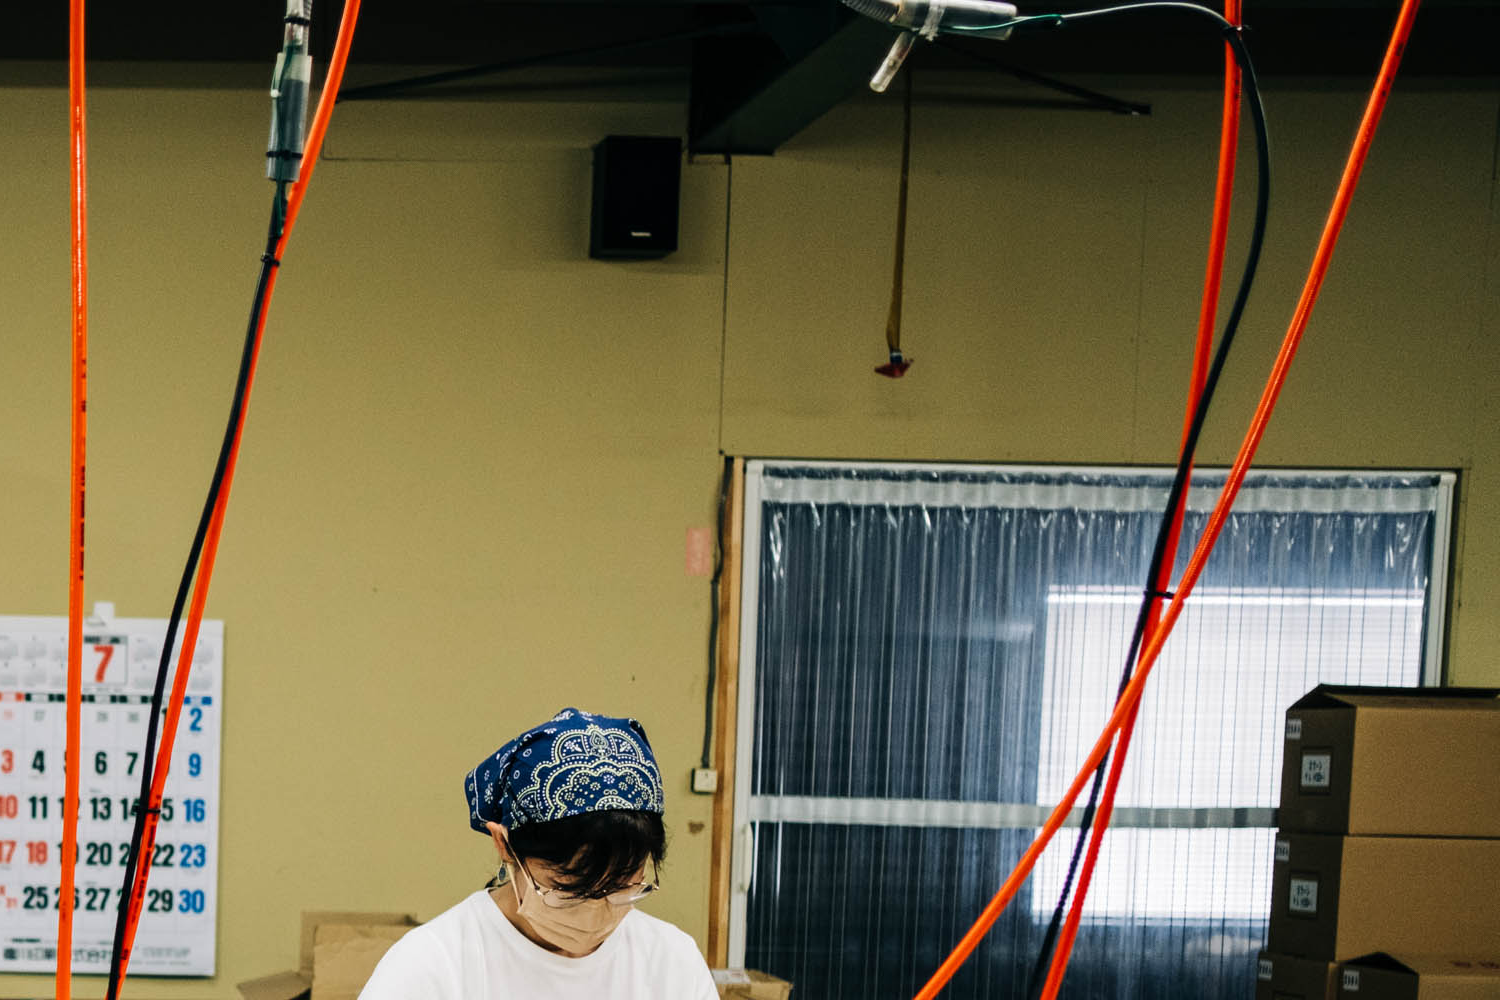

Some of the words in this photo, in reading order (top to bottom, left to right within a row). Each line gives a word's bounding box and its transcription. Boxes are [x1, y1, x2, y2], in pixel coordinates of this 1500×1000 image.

[93, 646, 114, 683] 7
[189, 707, 202, 732] 2
[0, 750, 14, 773] 3
[32, 750, 45, 773] 4
[94, 751, 107, 774] 6
[126, 752, 139, 774] 7
[188, 753, 202, 777] 9
[29, 796, 48, 819] 11
[90, 797, 112, 821] 13
[183, 799, 205, 823] 16
[27, 841, 48, 865] 18
[86, 843, 112, 866] 20
[180, 844, 205, 868] 23
[23, 887, 48, 910] 25
[85, 887, 110, 911] 27
[148, 889, 173, 912] 29
[178, 890, 204, 913] 30
